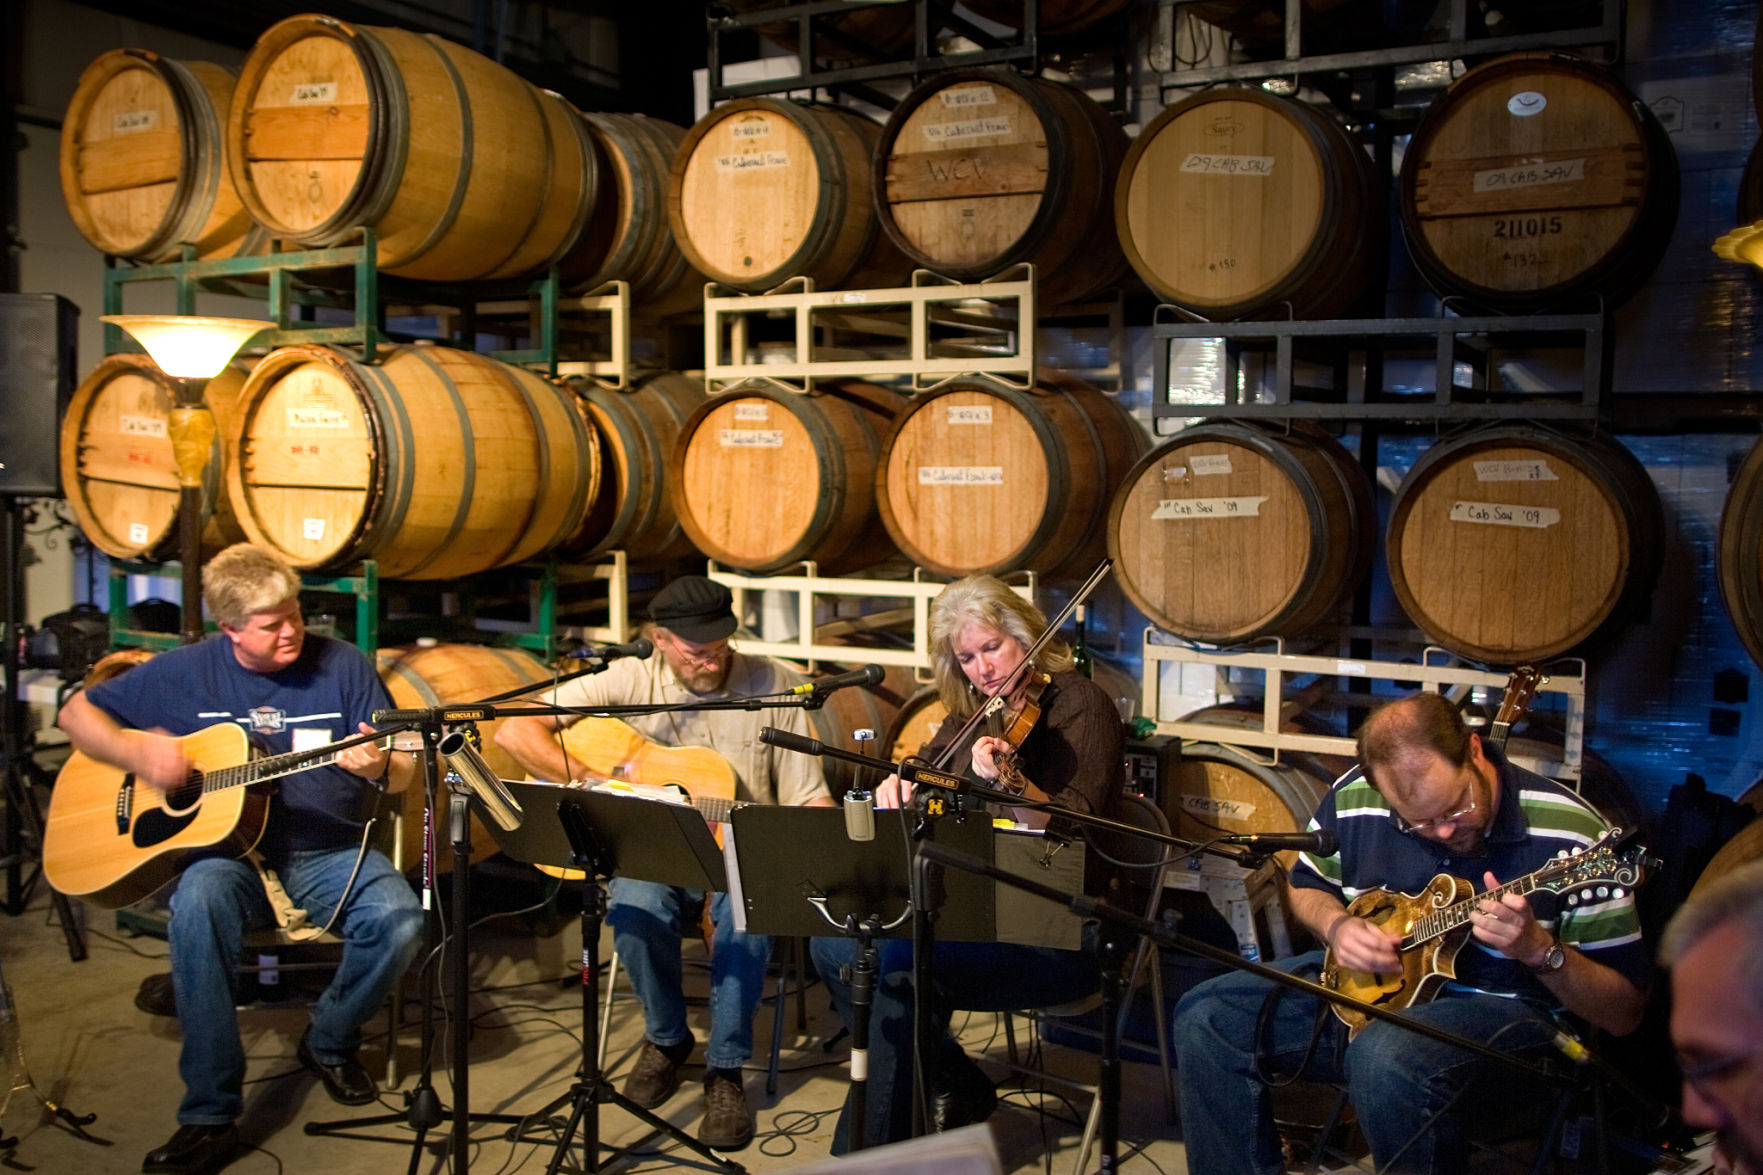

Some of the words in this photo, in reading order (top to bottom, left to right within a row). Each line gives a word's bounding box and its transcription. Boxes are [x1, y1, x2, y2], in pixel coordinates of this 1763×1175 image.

[1494, 215, 1563, 238] 211015
[1173, 501, 1192, 515] Cab
[1195, 500, 1213, 514] Sav
[1467, 504, 1490, 519] Cab
[1493, 506, 1513, 520] Sav
[1522, 509, 1540, 524] '09
[445, 711, 482, 719] HERCULES
[918, 772, 957, 788] HERCULES
[1213, 799, 1240, 814] SAV
